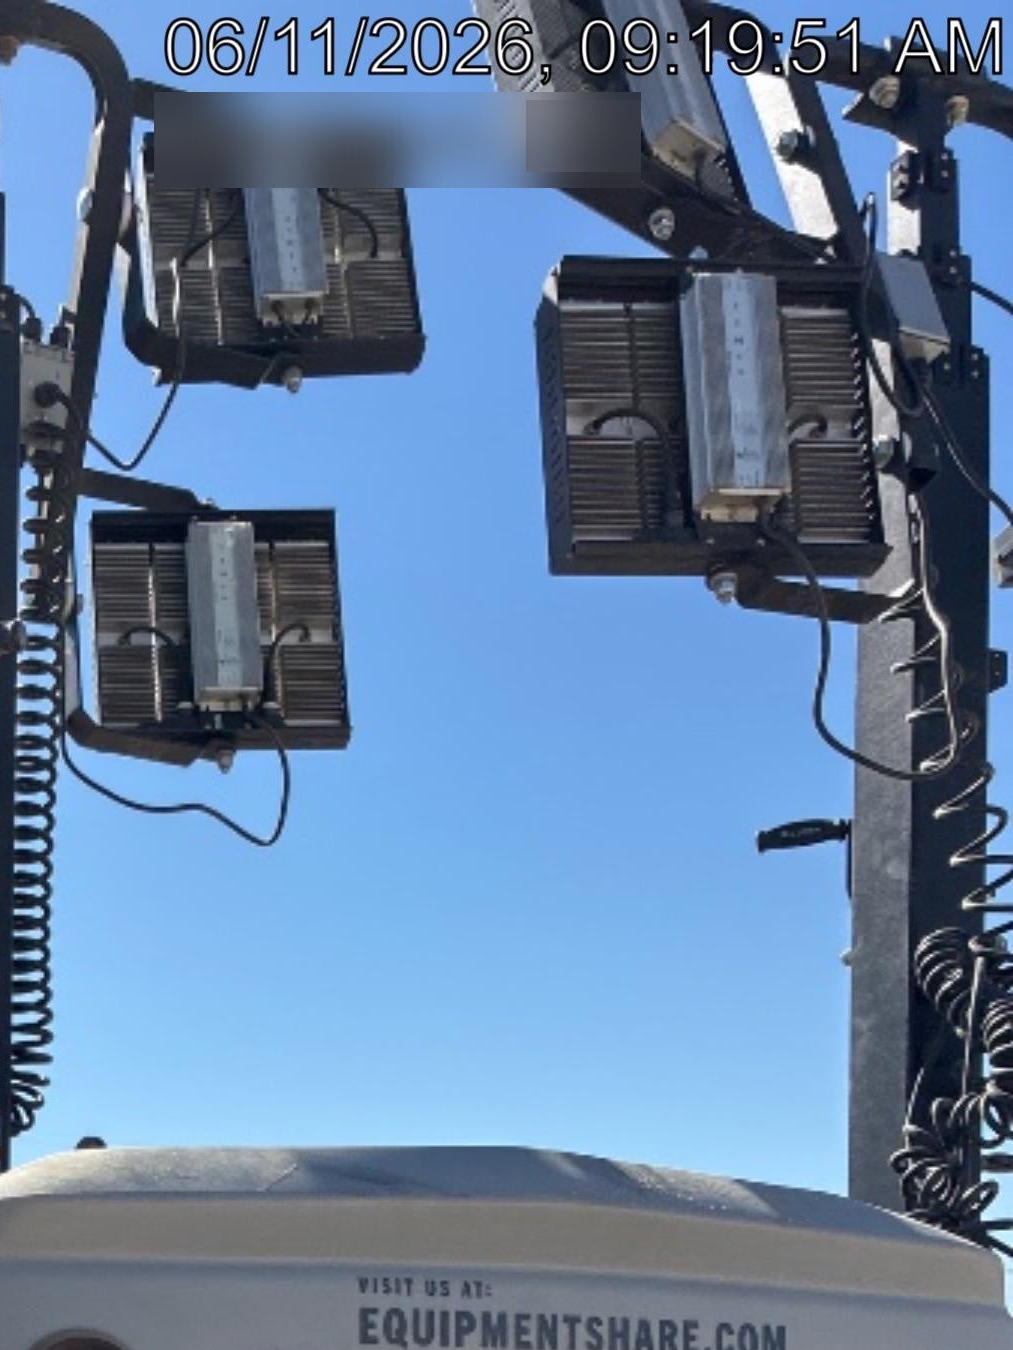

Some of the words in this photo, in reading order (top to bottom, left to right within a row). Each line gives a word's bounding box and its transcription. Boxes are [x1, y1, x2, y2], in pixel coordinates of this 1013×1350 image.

[356, 1276, 414, 1297] VISIT
[424, 1278, 451, 1297] US
[460, 1279, 494, 1299] AT:
